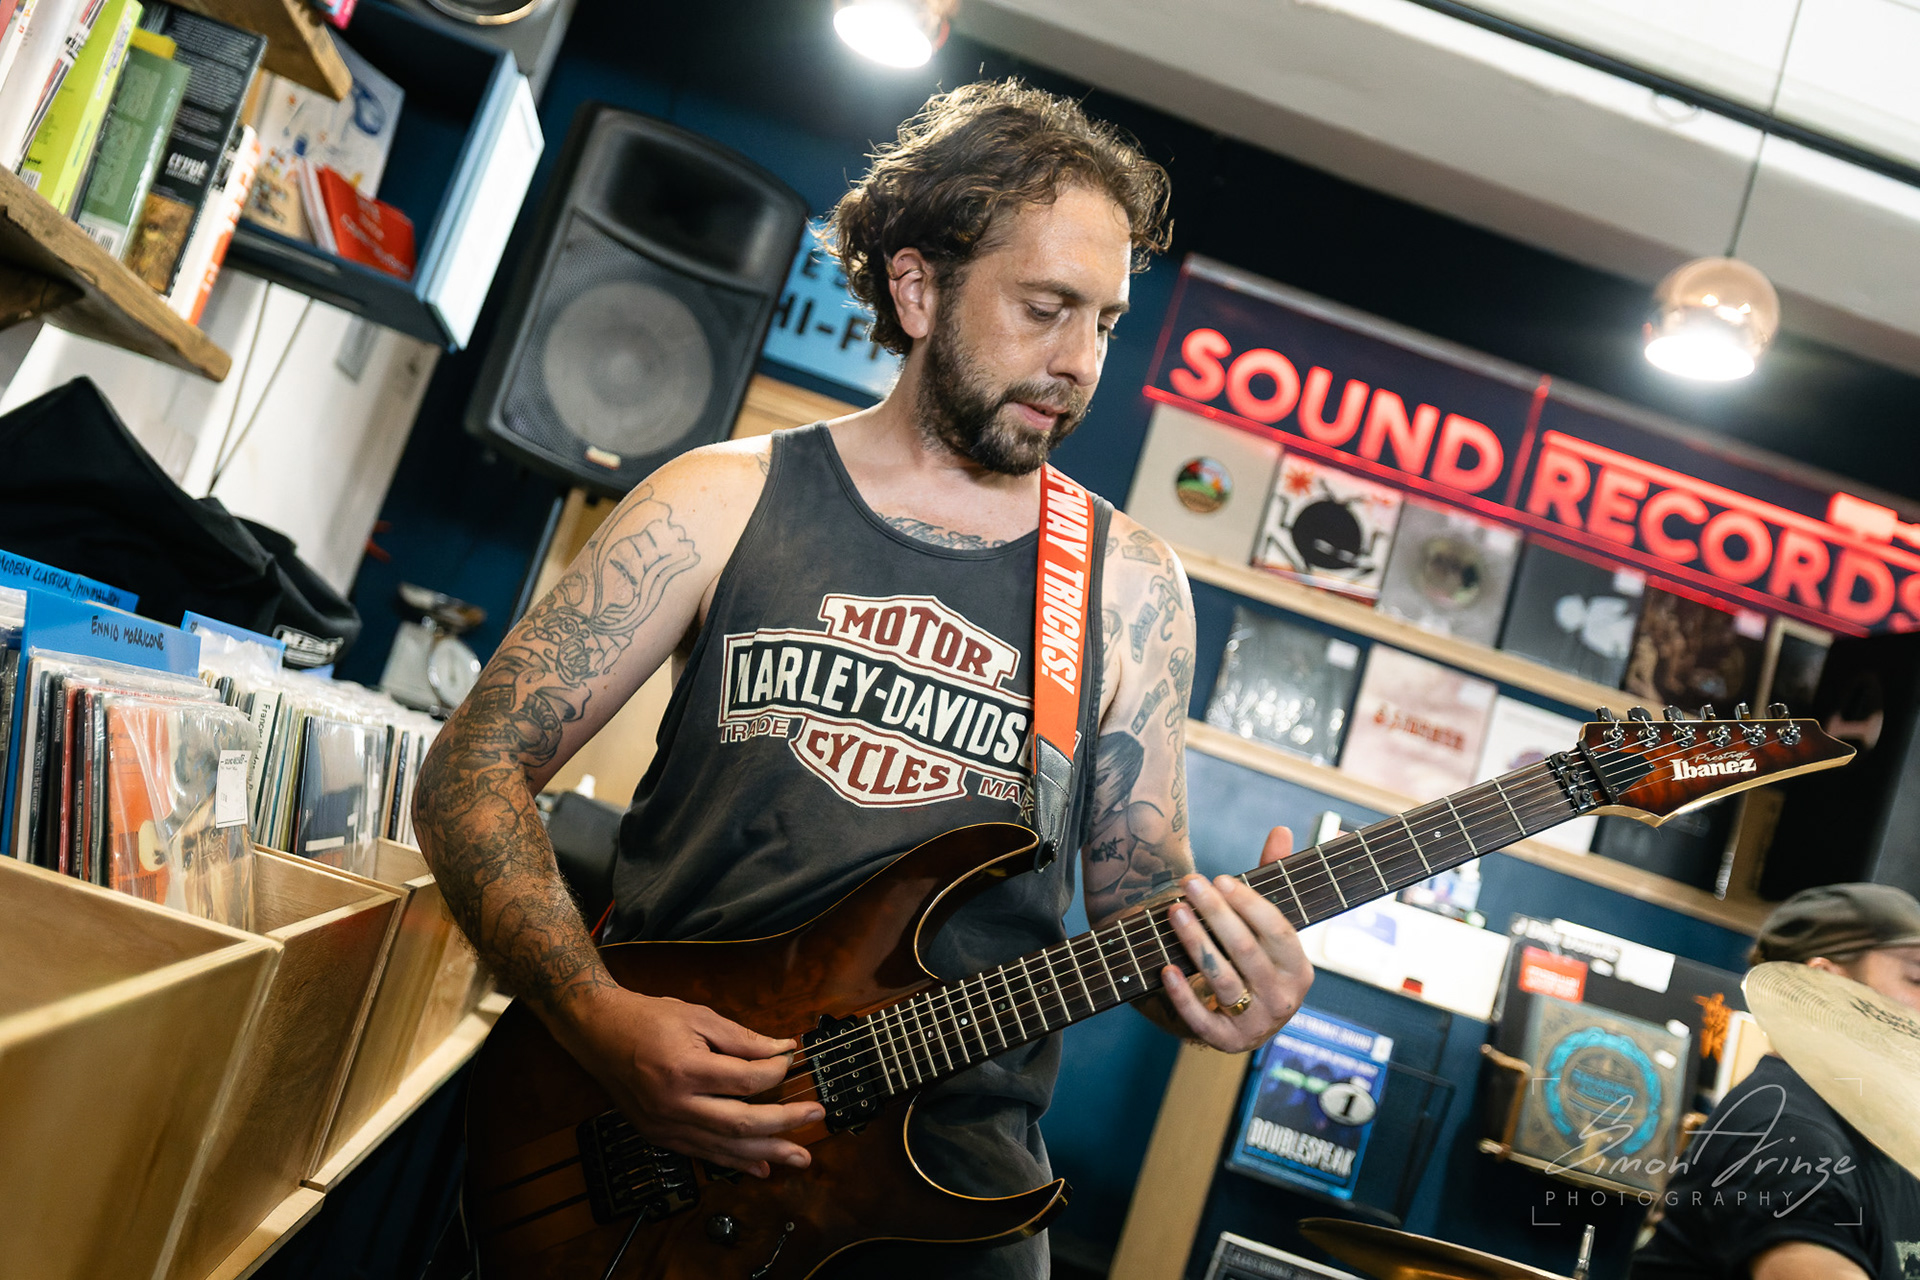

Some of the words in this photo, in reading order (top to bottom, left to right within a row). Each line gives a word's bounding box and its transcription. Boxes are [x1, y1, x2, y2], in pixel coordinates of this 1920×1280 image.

[1168, 327, 1505, 494] SOUND
[32, 567, 72, 593] CLASSICAL
[91, 615, 119, 642] ENNIO
[123, 626, 165, 651] MORRICONE
[838, 604, 993, 678] MOTOR
[1041, 559, 1085, 696] TRICKS!
[720, 715, 790, 743] TRADE
[732, 645, 1035, 767] HARLEY-DAVIDS
[805, 729, 951, 798] CYCLES
[1669, 758, 1757, 781] Ibanez
[1694, 750, 1751, 764] Prestige
[1246, 1116, 1357, 1178] DOUBLESPEAK
